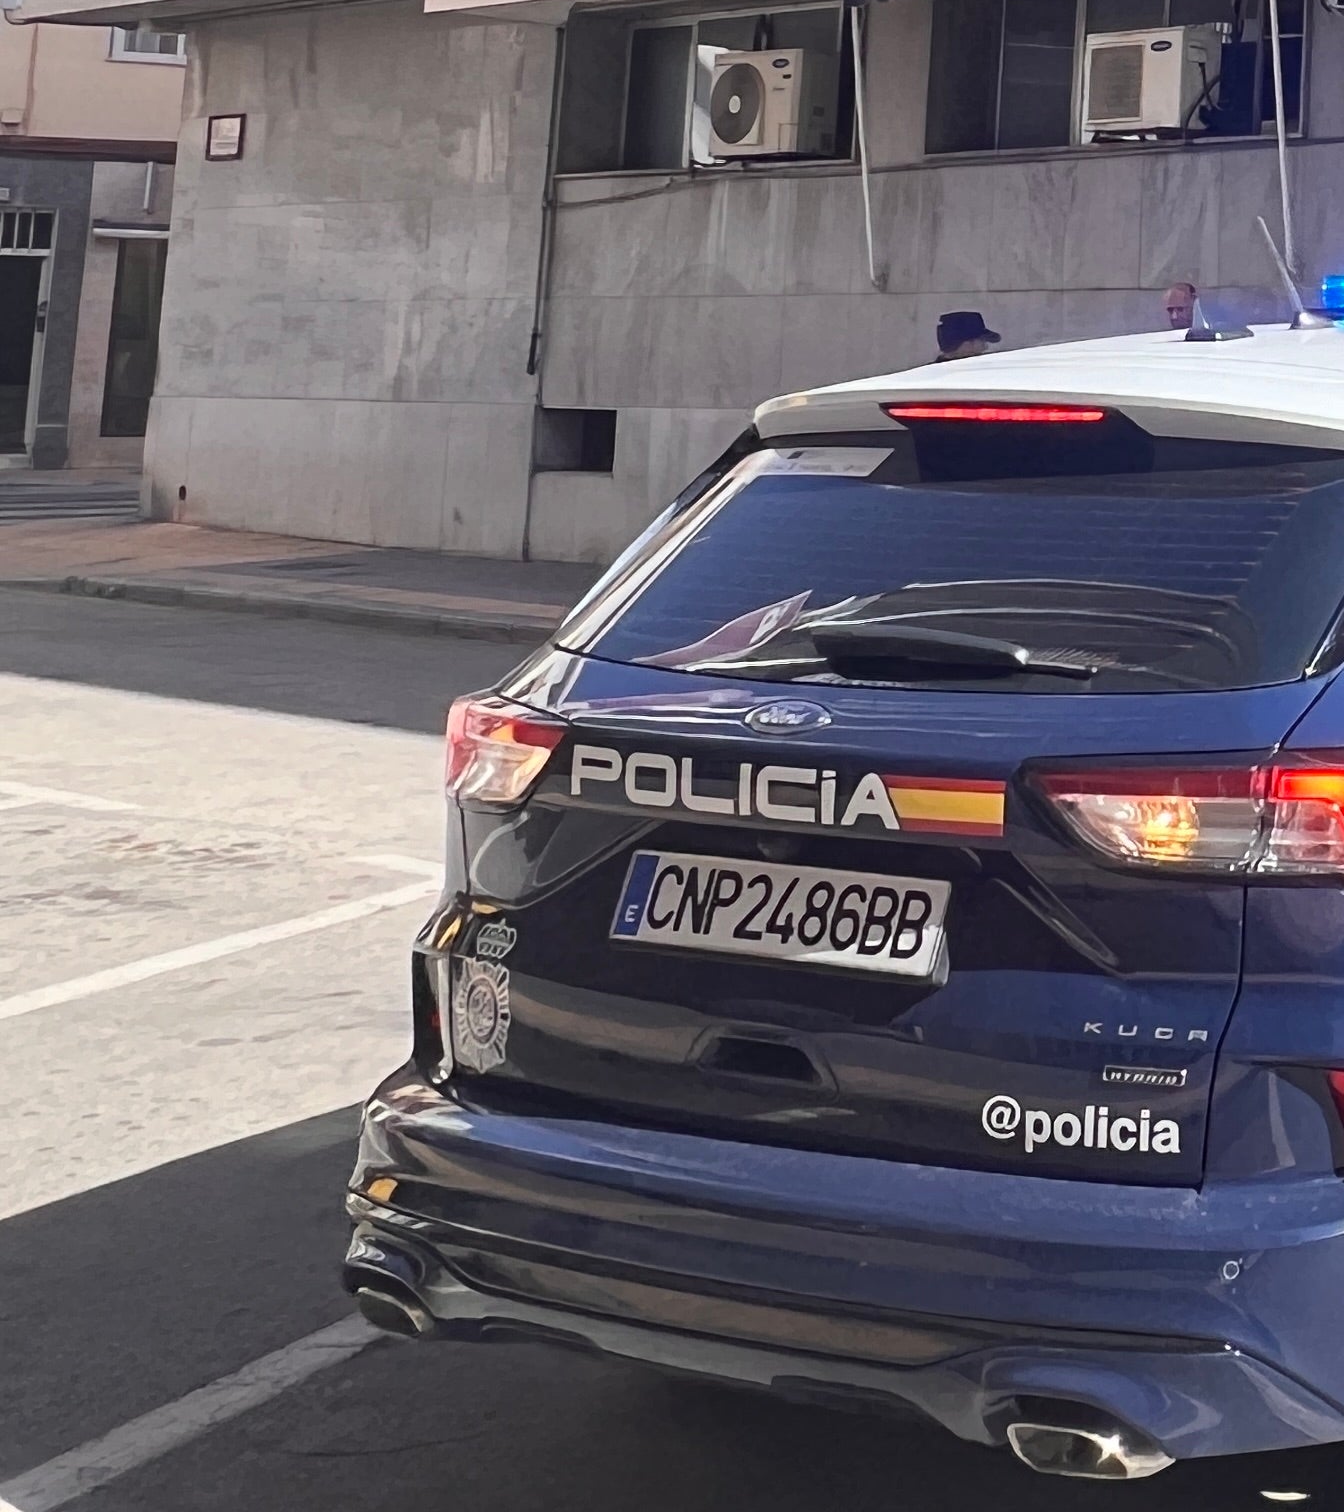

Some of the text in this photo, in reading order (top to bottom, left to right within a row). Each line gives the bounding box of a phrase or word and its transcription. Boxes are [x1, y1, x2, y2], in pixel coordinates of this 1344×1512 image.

[623, 864, 933, 960] E CNP2486BB
[981, 1094, 1181, 1155] @policia
